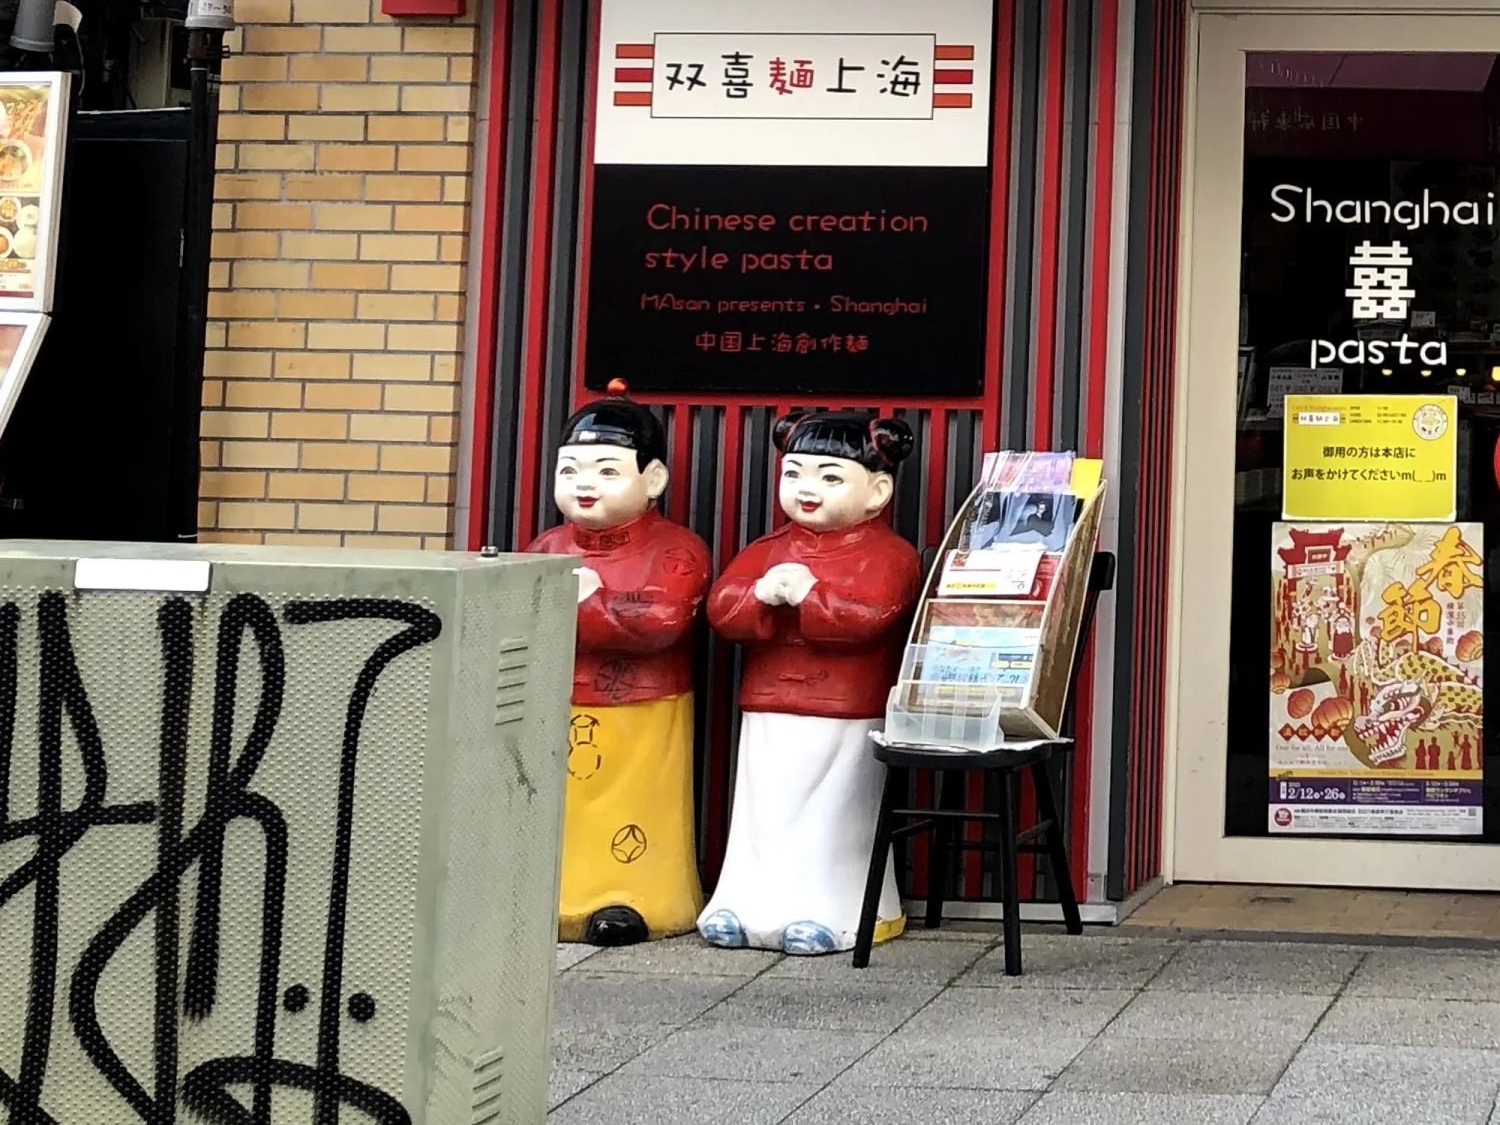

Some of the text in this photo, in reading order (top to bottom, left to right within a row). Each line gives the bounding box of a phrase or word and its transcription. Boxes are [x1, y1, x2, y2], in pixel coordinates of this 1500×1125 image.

[646, 203, 929, 233] Chinese creation
[1271, 184, 1495, 230] Shanghai
[645, 247, 833, 274] style pasta
[717, 298, 806, 314] presents
[830, 294, 927, 317] Shanghai
[1310, 333, 1447, 370] pasta
[1322, 446, 1416, 459] 御用の方は本店に
